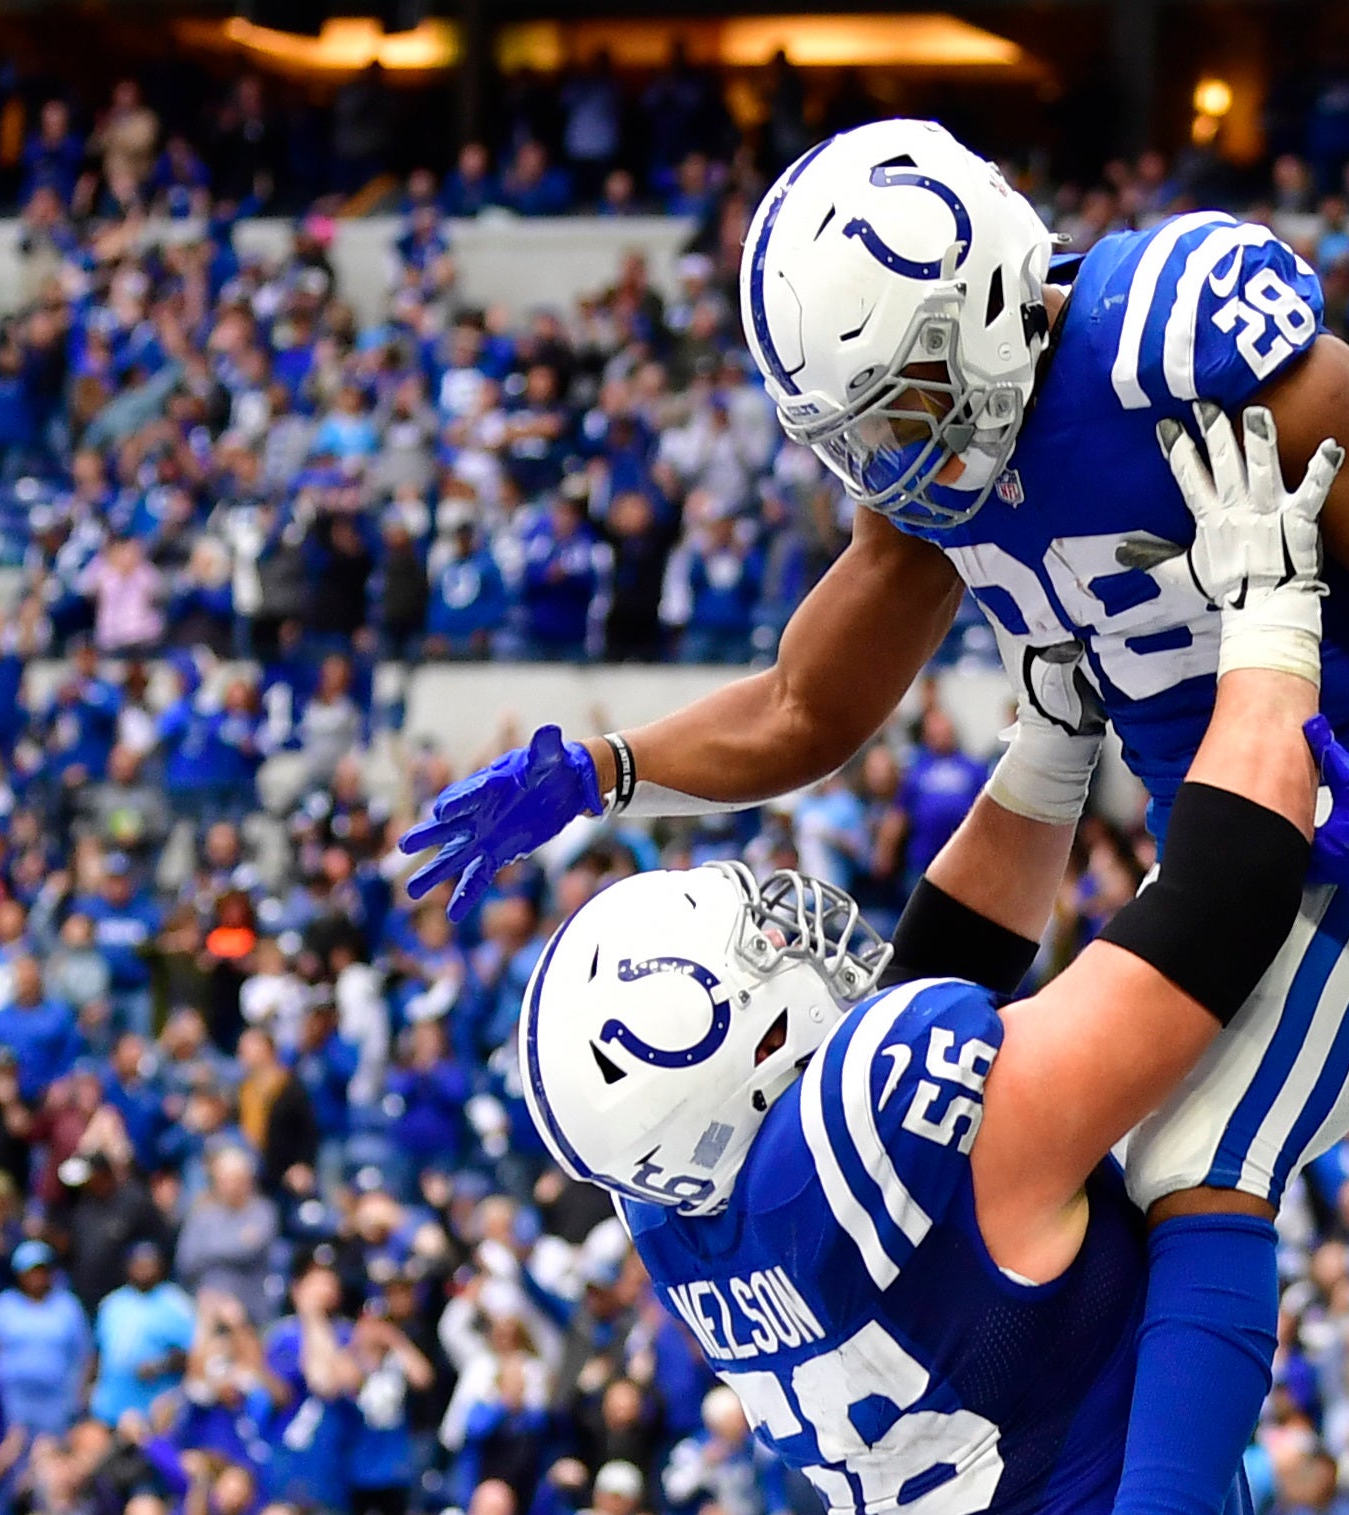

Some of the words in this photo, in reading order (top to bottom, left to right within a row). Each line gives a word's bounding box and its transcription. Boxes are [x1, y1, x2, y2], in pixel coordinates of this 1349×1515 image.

[1211, 267, 1316, 381] 28
[901, 1026, 999, 1156] 56
[667, 1265, 826, 1361] NELSON
